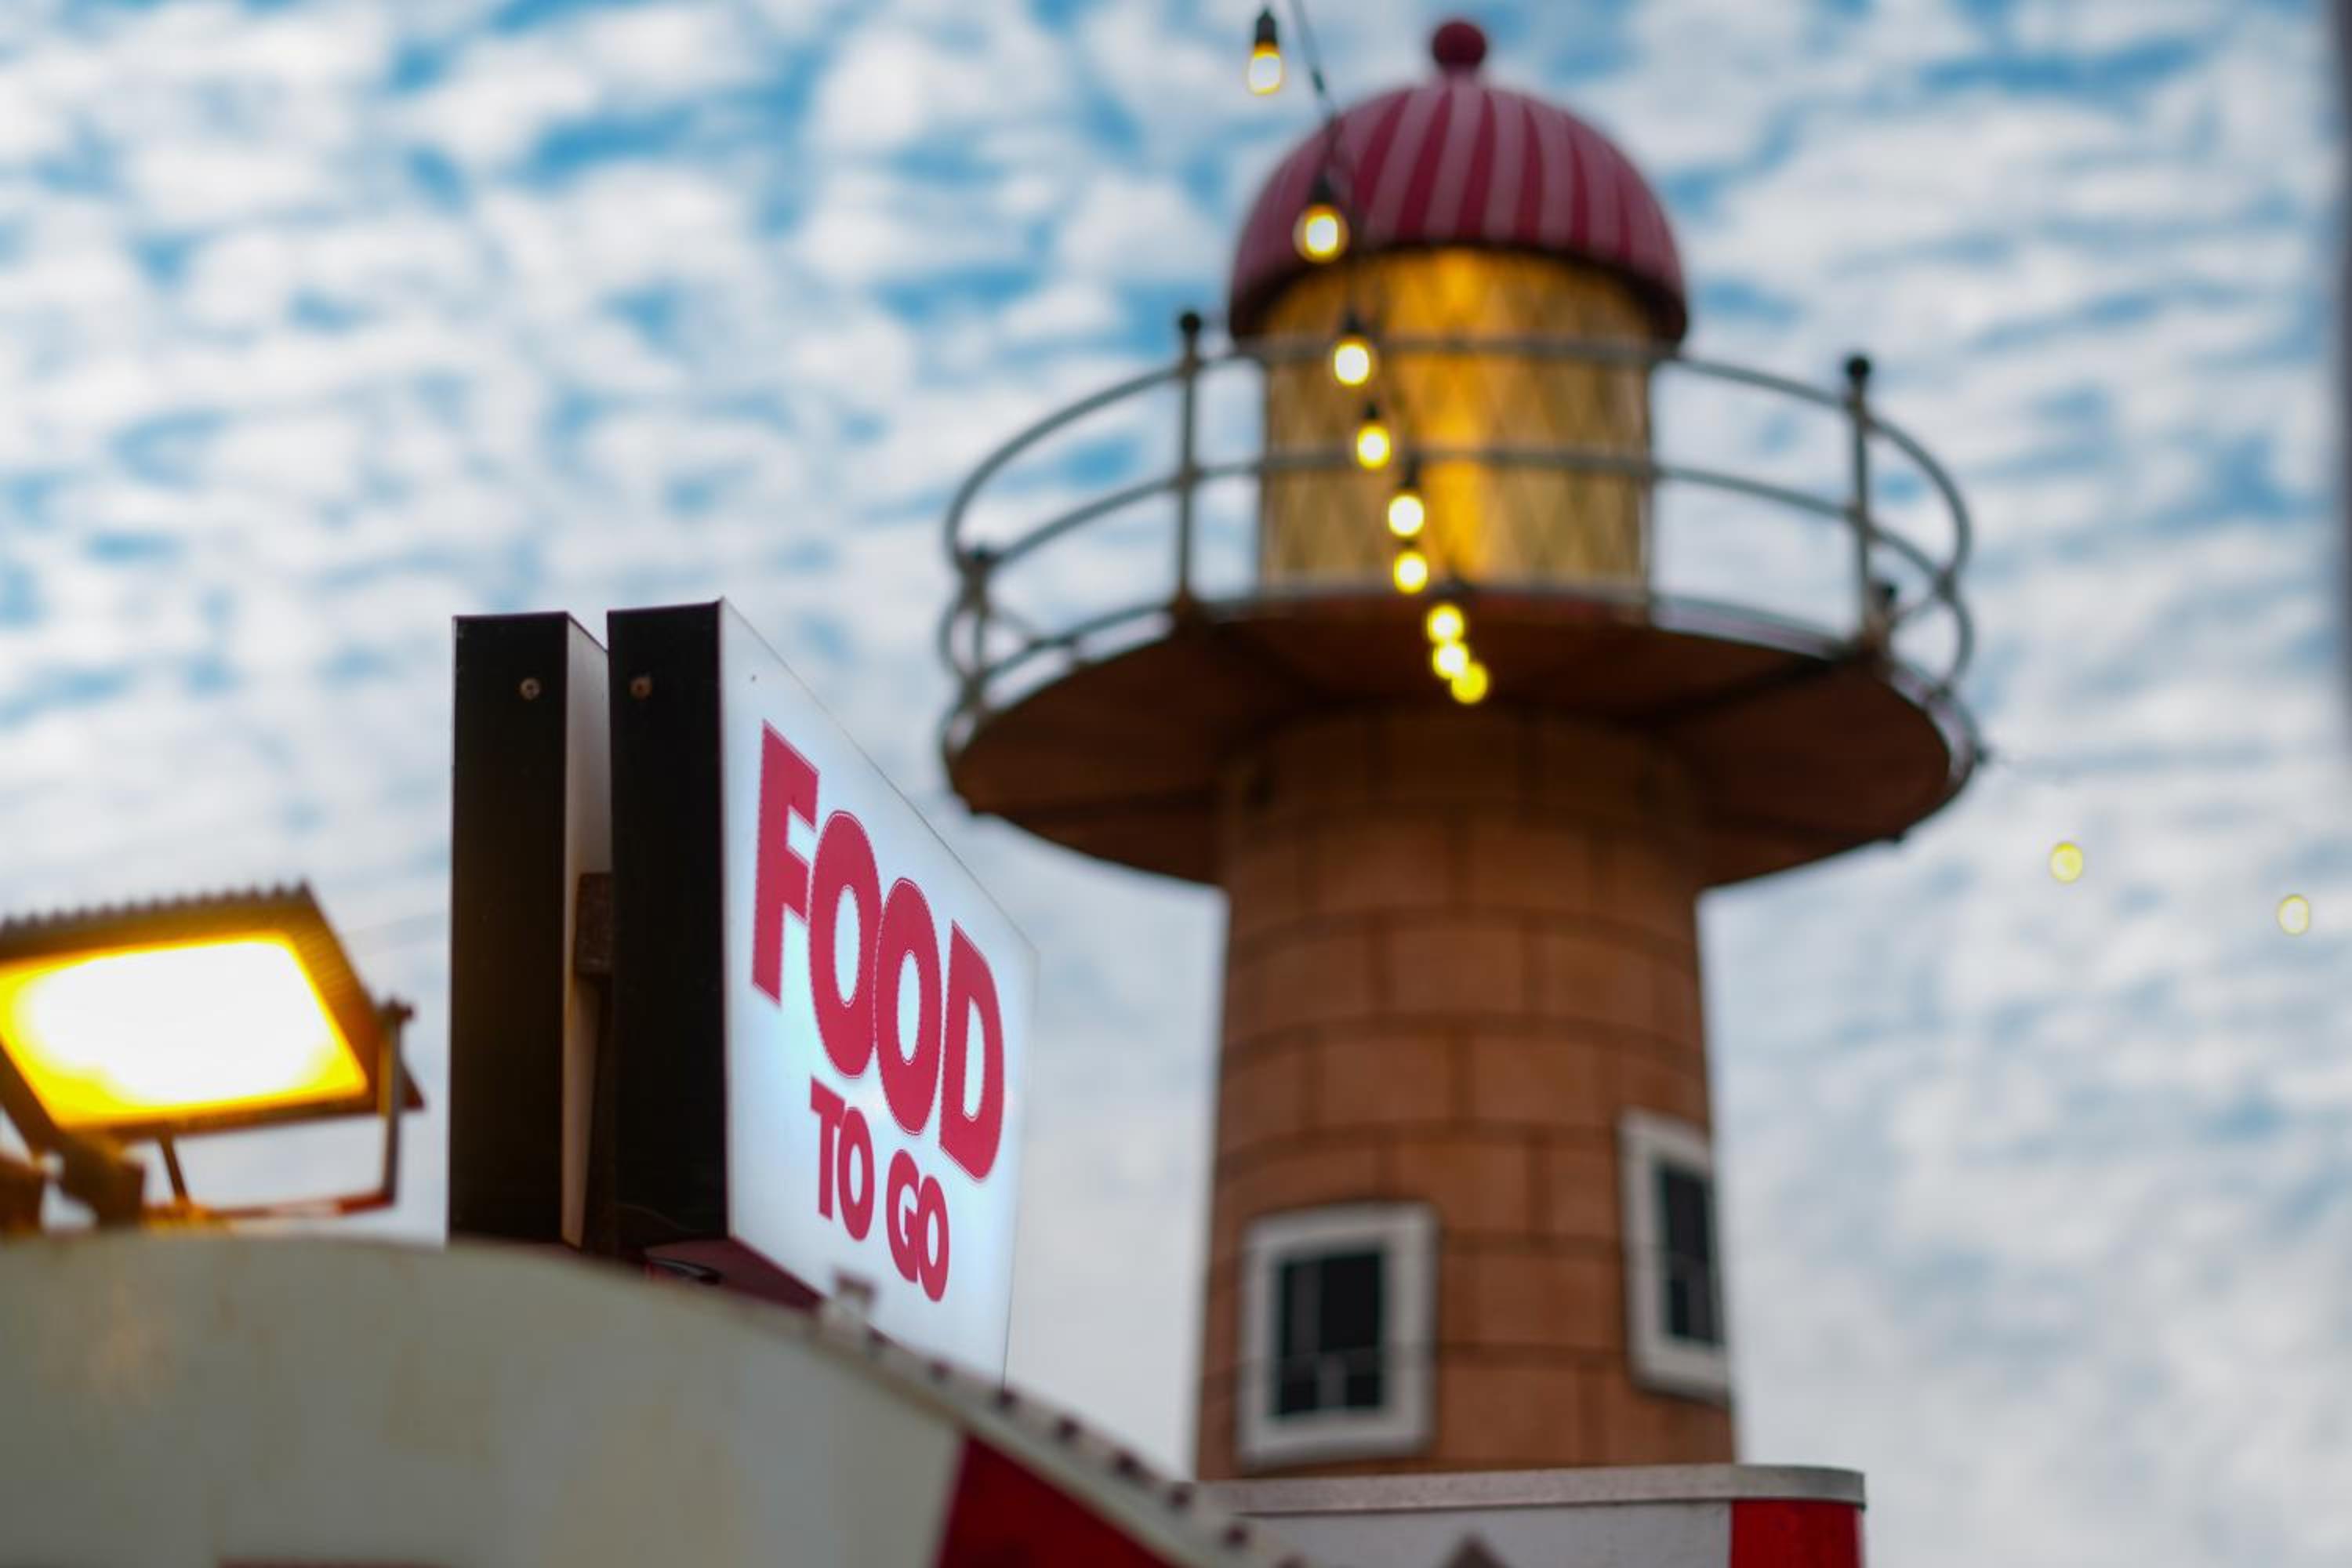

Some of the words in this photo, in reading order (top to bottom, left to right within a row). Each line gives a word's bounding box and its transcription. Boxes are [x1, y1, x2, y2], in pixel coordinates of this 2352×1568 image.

[752, 719, 1004, 1181] FOOD
[810, 1076, 874, 1241] TO
[886, 1149, 949, 1301] GO
